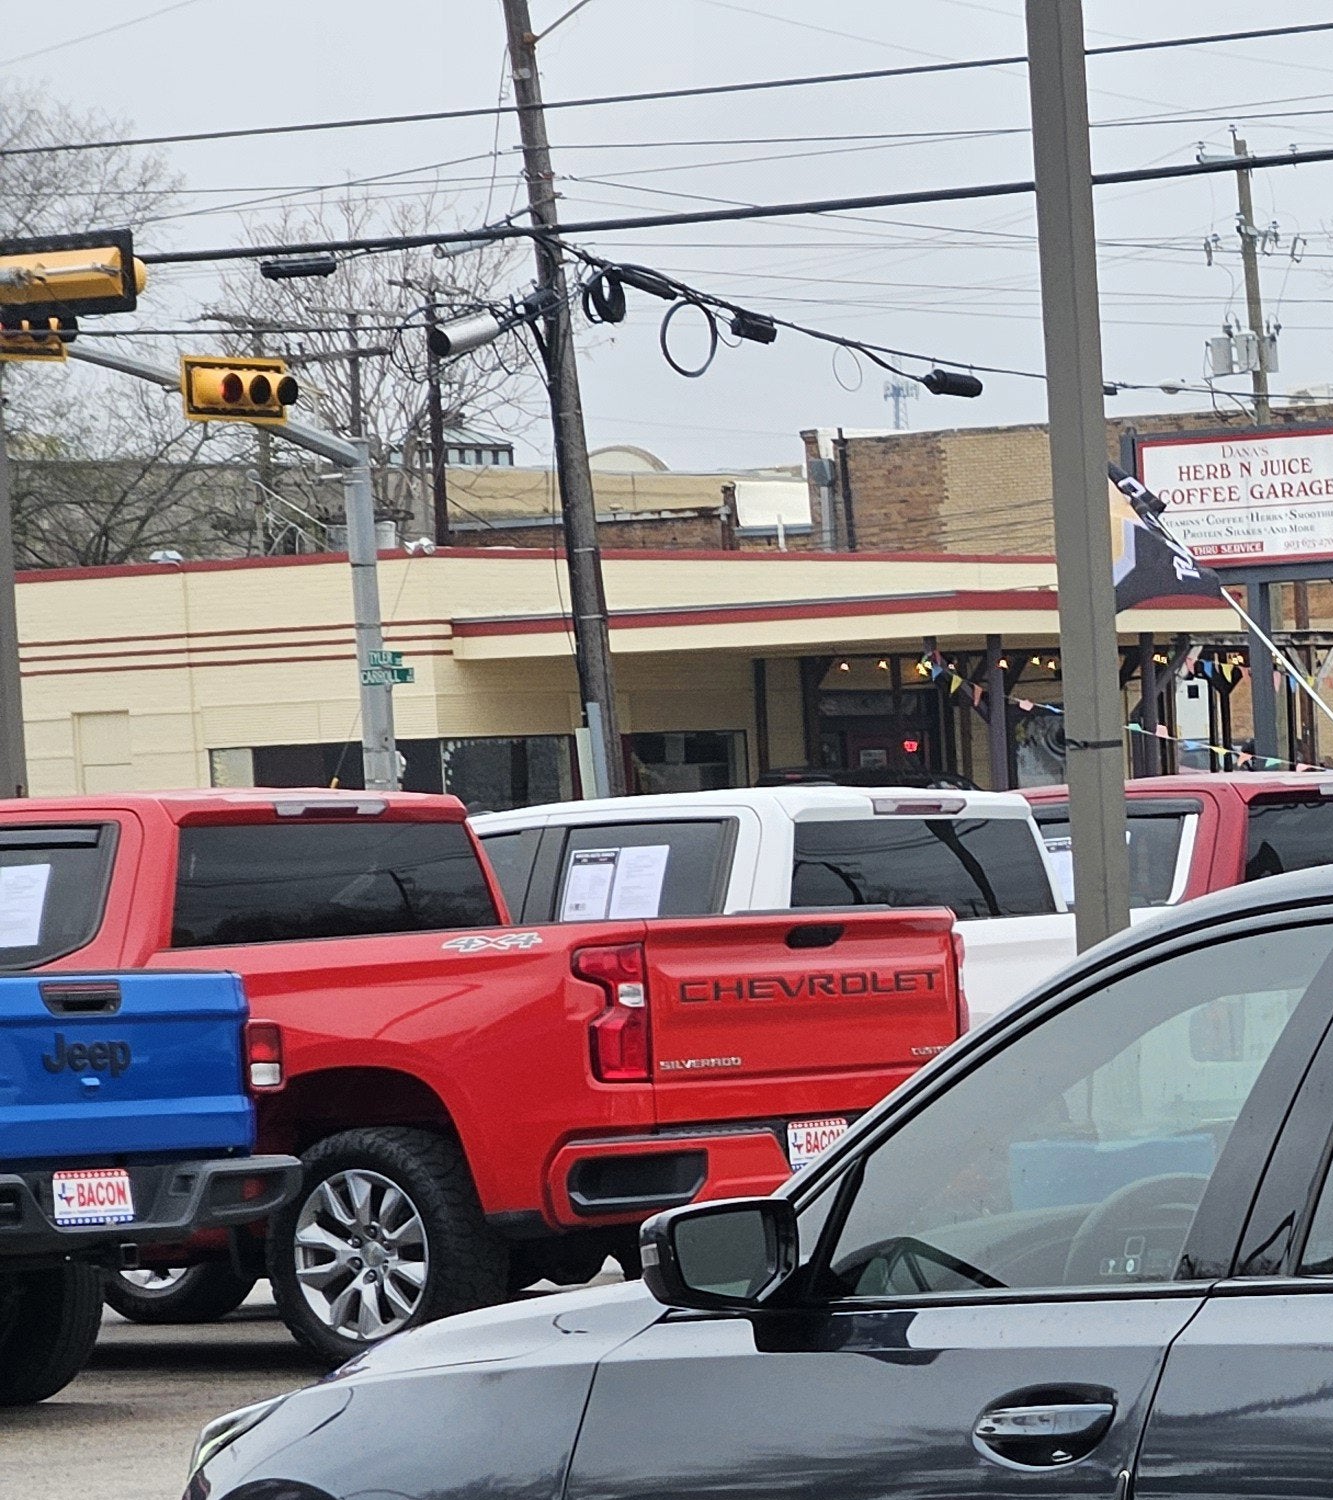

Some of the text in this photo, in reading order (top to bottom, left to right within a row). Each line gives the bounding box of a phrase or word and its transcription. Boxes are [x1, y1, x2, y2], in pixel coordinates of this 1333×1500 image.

[1179, 458, 1313, 482] HERB N JUICE
[1158, 484, 1241, 506] COFFEE
[1206, 513, 1243, 526] COFFEE
[1183, 528, 1224, 539] PROTEIN
[1225, 526, 1262, 538] SHAKES
[1289, 523, 1316, 534] MORE
[1192, 542, 1262, 557] THRU SERVICE
[679, 968, 941, 1004] CHEVROLET
[42, 1032, 132, 1078] Jeep
[659, 1056, 742, 1070] SILVERADO
[76, 1181, 128, 1207] BACON
